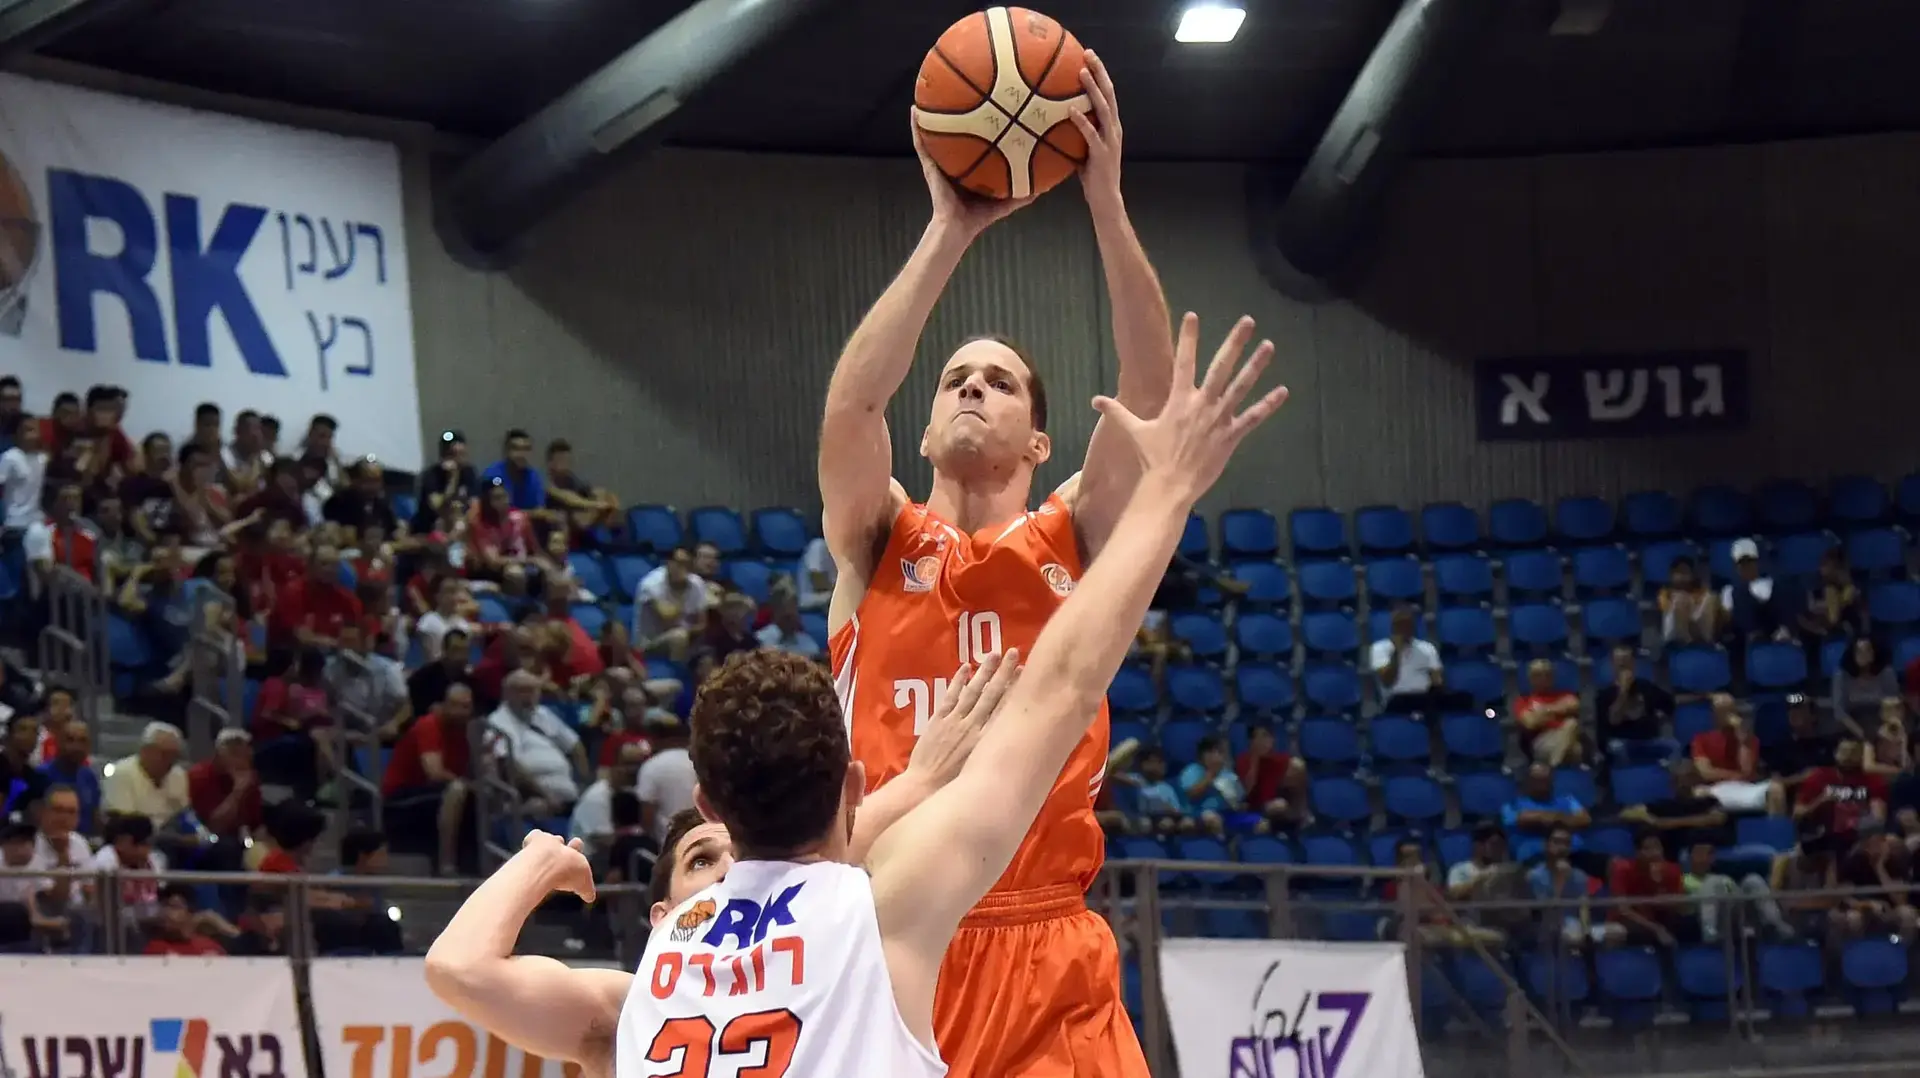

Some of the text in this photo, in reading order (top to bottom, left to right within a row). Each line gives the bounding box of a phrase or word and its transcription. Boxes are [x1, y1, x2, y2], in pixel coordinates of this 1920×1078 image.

[47, 166, 290, 378] RK
[275, 212, 388, 291] רענן
[305, 310, 374, 392] כץ
[1500, 364, 1725, 424] גוש א
[958, 610, 1002, 664] 10
[700, 879, 807, 950] RK
